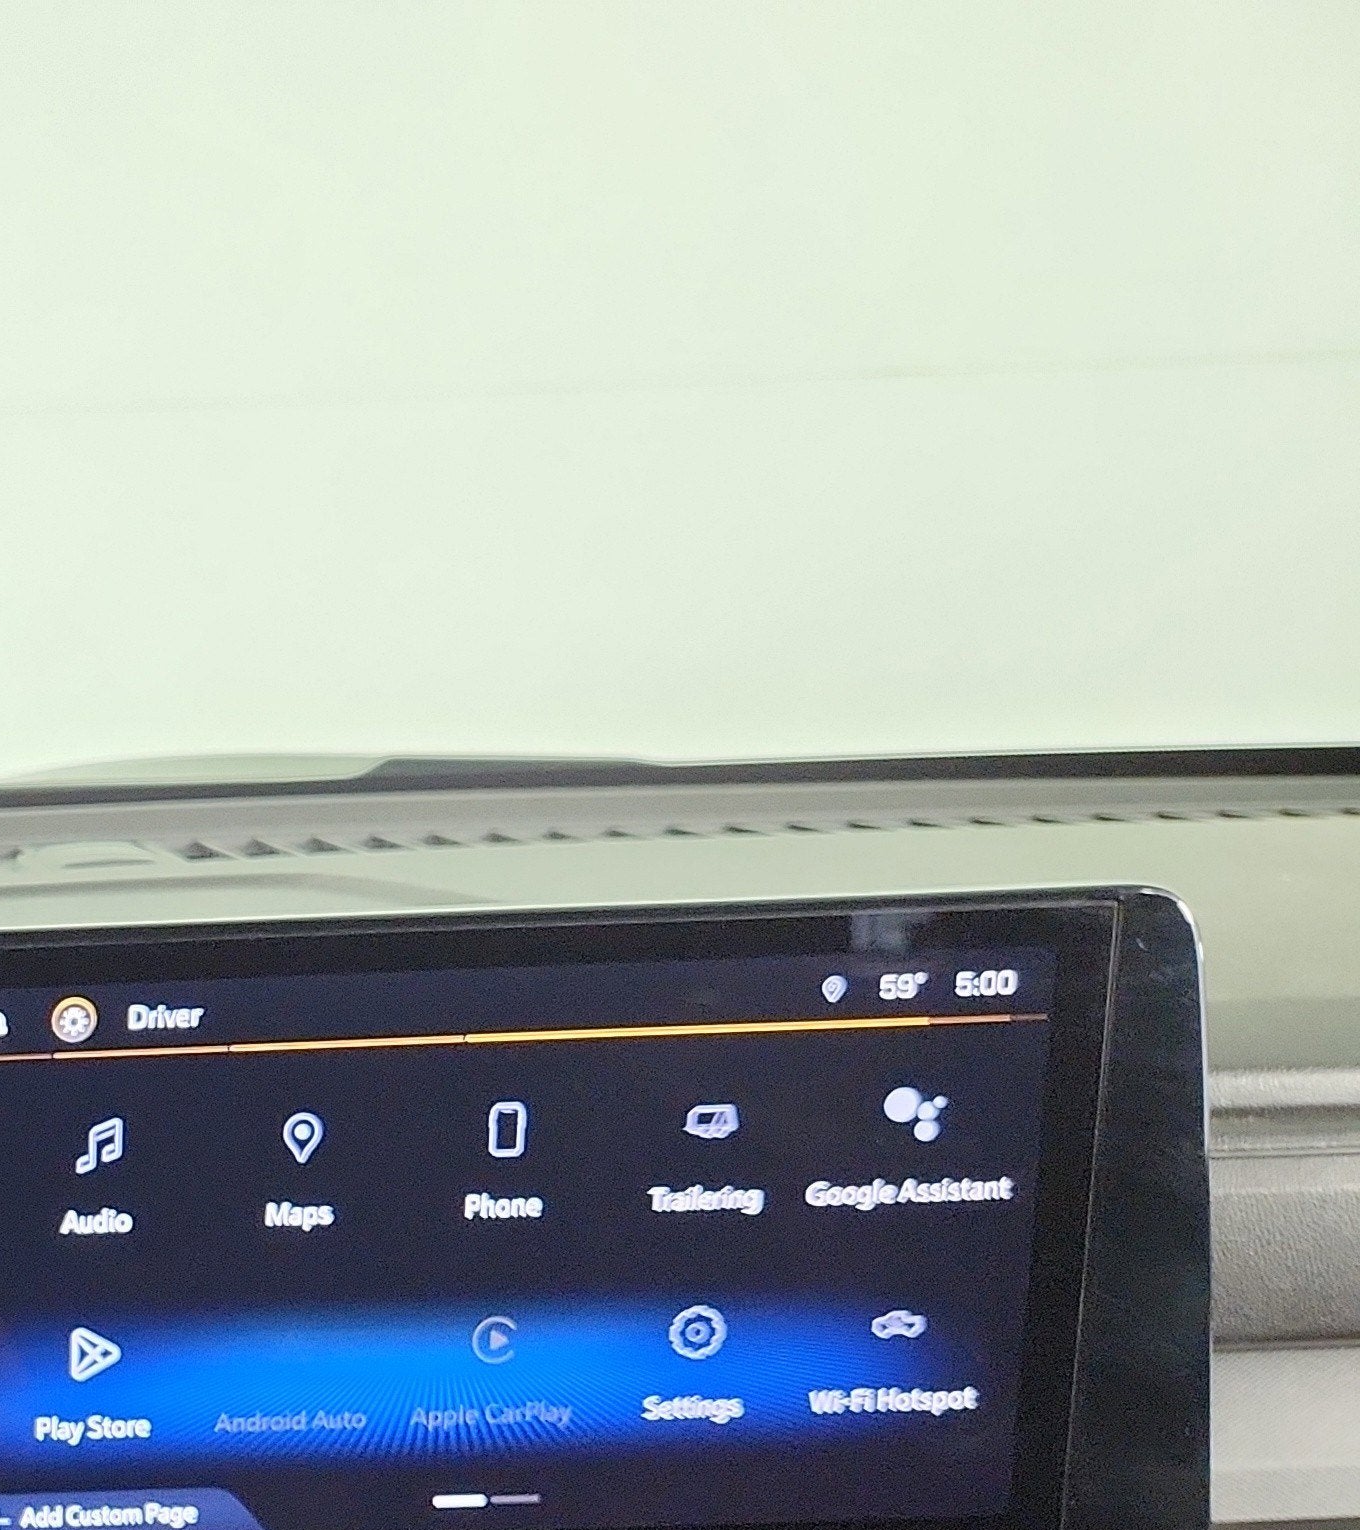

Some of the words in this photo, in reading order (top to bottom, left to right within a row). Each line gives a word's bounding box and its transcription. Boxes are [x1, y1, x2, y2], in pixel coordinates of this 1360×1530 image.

[954, 968, 1019, 998] 5:00
[127, 1002, 204, 1031] Driver
[463, 1193, 544, 1220] Phone
[646, 1185, 765, 1215] Trailering
[804, 1179, 897, 1210] Google
[897, 1177, 1015, 1203] Assistant
[59, 1206, 133, 1236] Audio
[264, 1201, 335, 1232] Maps
[641, 1395, 745, 1424] Settings
[808, 1388, 876, 1415] Wi-Fi
[878, 1386, 979, 1417] Hotspot
[34, 1416, 83, 1445] Play
[87, 1413, 151, 1440] Store
[214, 1411, 306, 1434] Android
[311, 1410, 367, 1430] Auto
[411, 1405, 478, 1431] Apple
[484, 1403, 572, 1430] CarPlay
[19, 1506, 65, 1530] Add
[66, 1504, 141, 1528] Custom
[145, 1503, 199, 1529] Page
